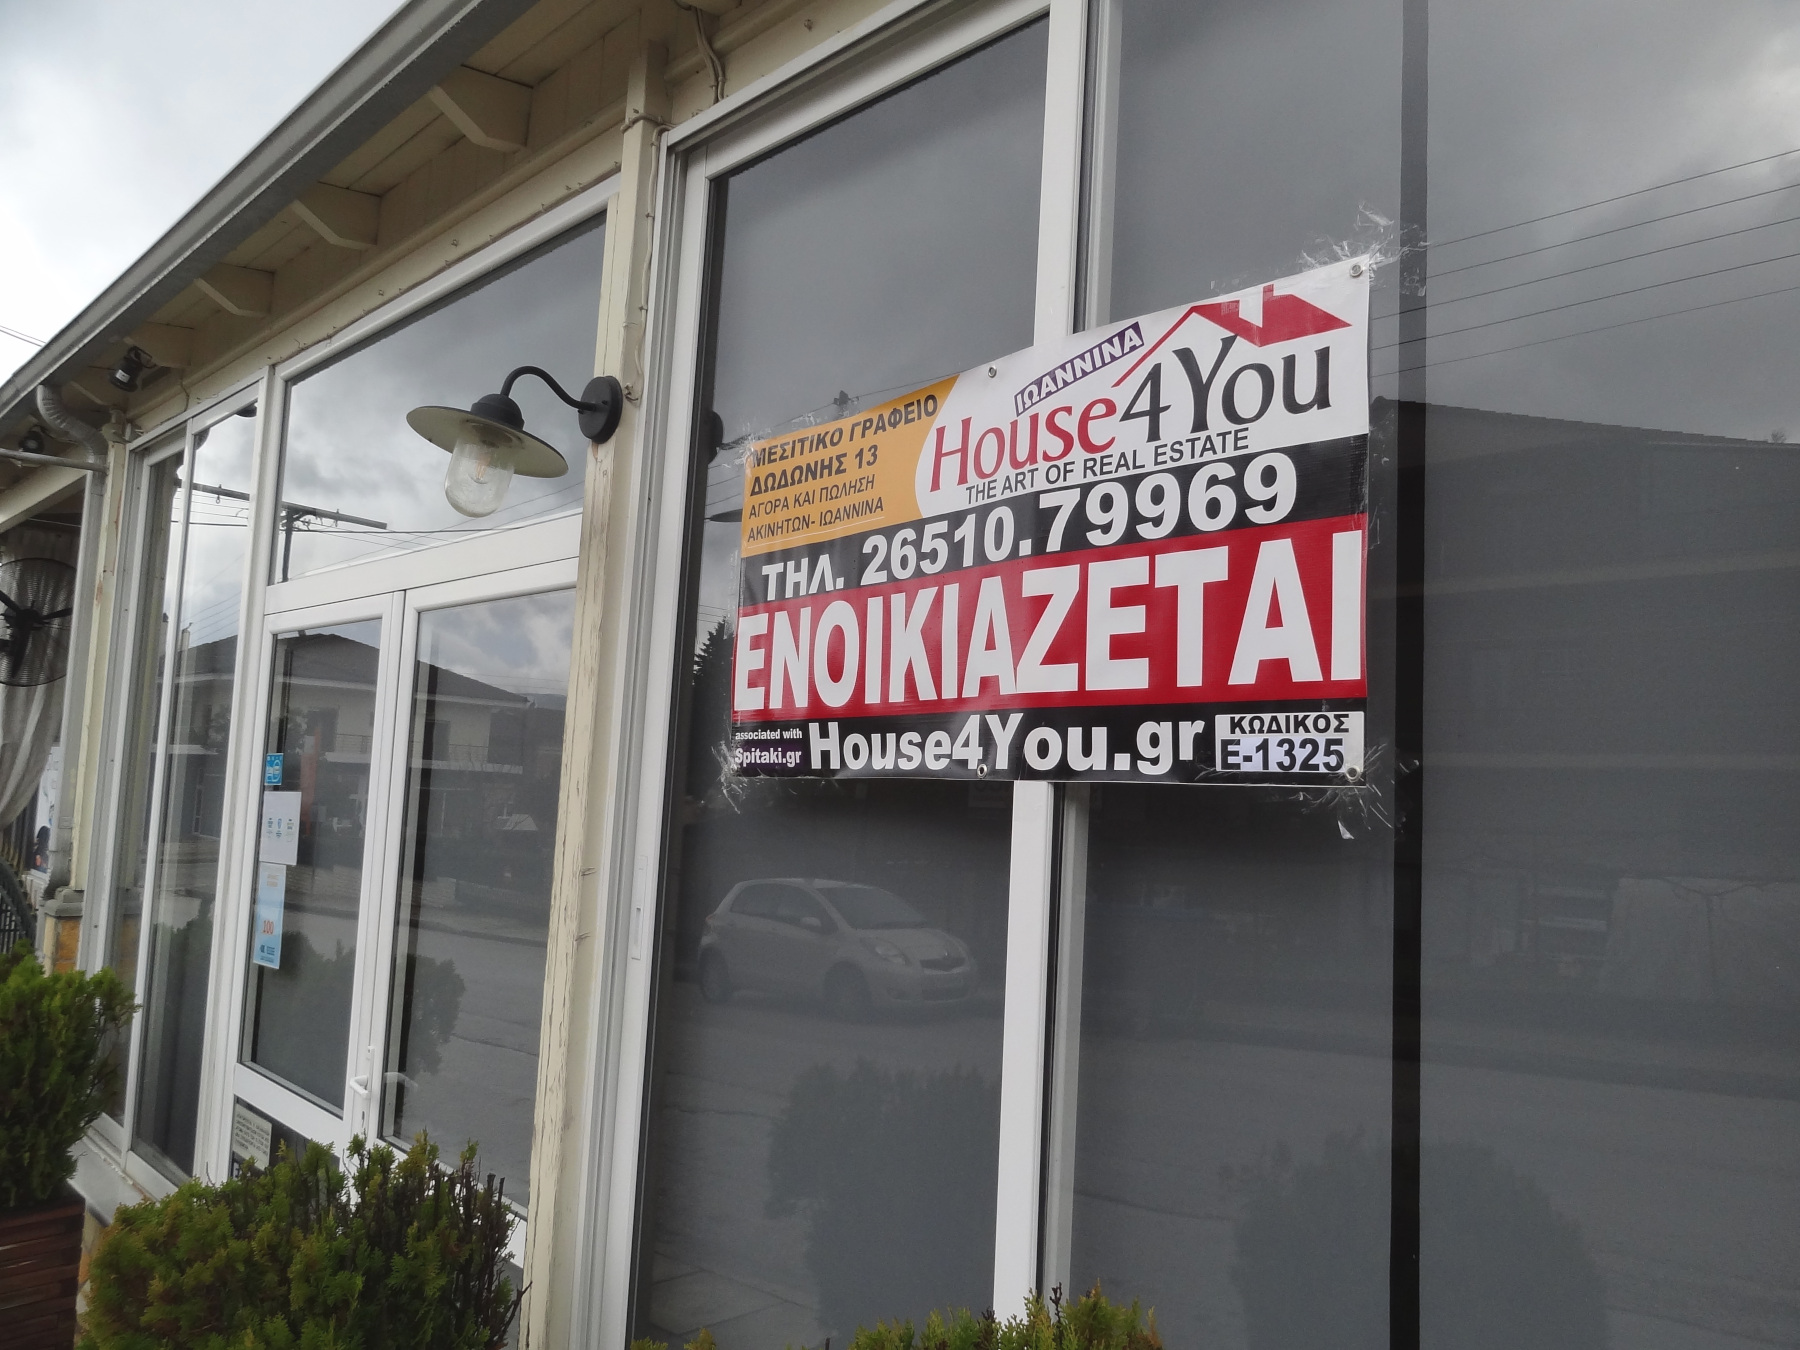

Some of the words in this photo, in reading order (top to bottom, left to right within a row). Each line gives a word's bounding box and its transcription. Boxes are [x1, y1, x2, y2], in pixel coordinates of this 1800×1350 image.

[1016, 327, 1143, 414] ΙΩΑΝΝΙΝΑ
[752, 428, 843, 468] ΜΕΣΙΤΙΚΟ
[849, 394, 939, 442] ΓΡΑΦΕΙΟ
[930, 334, 1332, 493] House4You
[749, 496, 789, 520] ΑΓΟΡΑ
[793, 489, 816, 509] ΚΑΙ
[819, 473, 876, 503] ΠΩΛΗΣΗ
[750, 452, 848, 497] ΔΩΔΩΝΗΣ
[854, 444, 878, 469] 13
[966, 478, 997, 505] THE
[1001, 468, 1039, 497] ART
[1045, 460, 1075, 485] OF
[1083, 449, 1145, 478] REAL
[1154, 427, 1249, 465] ESTATE
[761, 554, 845, 602] ΤΗΛ.
[860, 452, 1298, 587] 26510.79969
[819, 496, 884, 526] ΙΩΑΝΝΙΝΑ
[733, 529, 1364, 712] ΕΝΟΙΚΙΑΖΕΤΑΙ
[735, 729, 781, 741] associated
[782, 728, 803, 740] with
[808, 712, 1206, 776] House4You.gr
[1229, 713, 1350, 735] ΚΩΔΙΚΟΣ
[735, 747, 803, 768] Spitaki.gr
